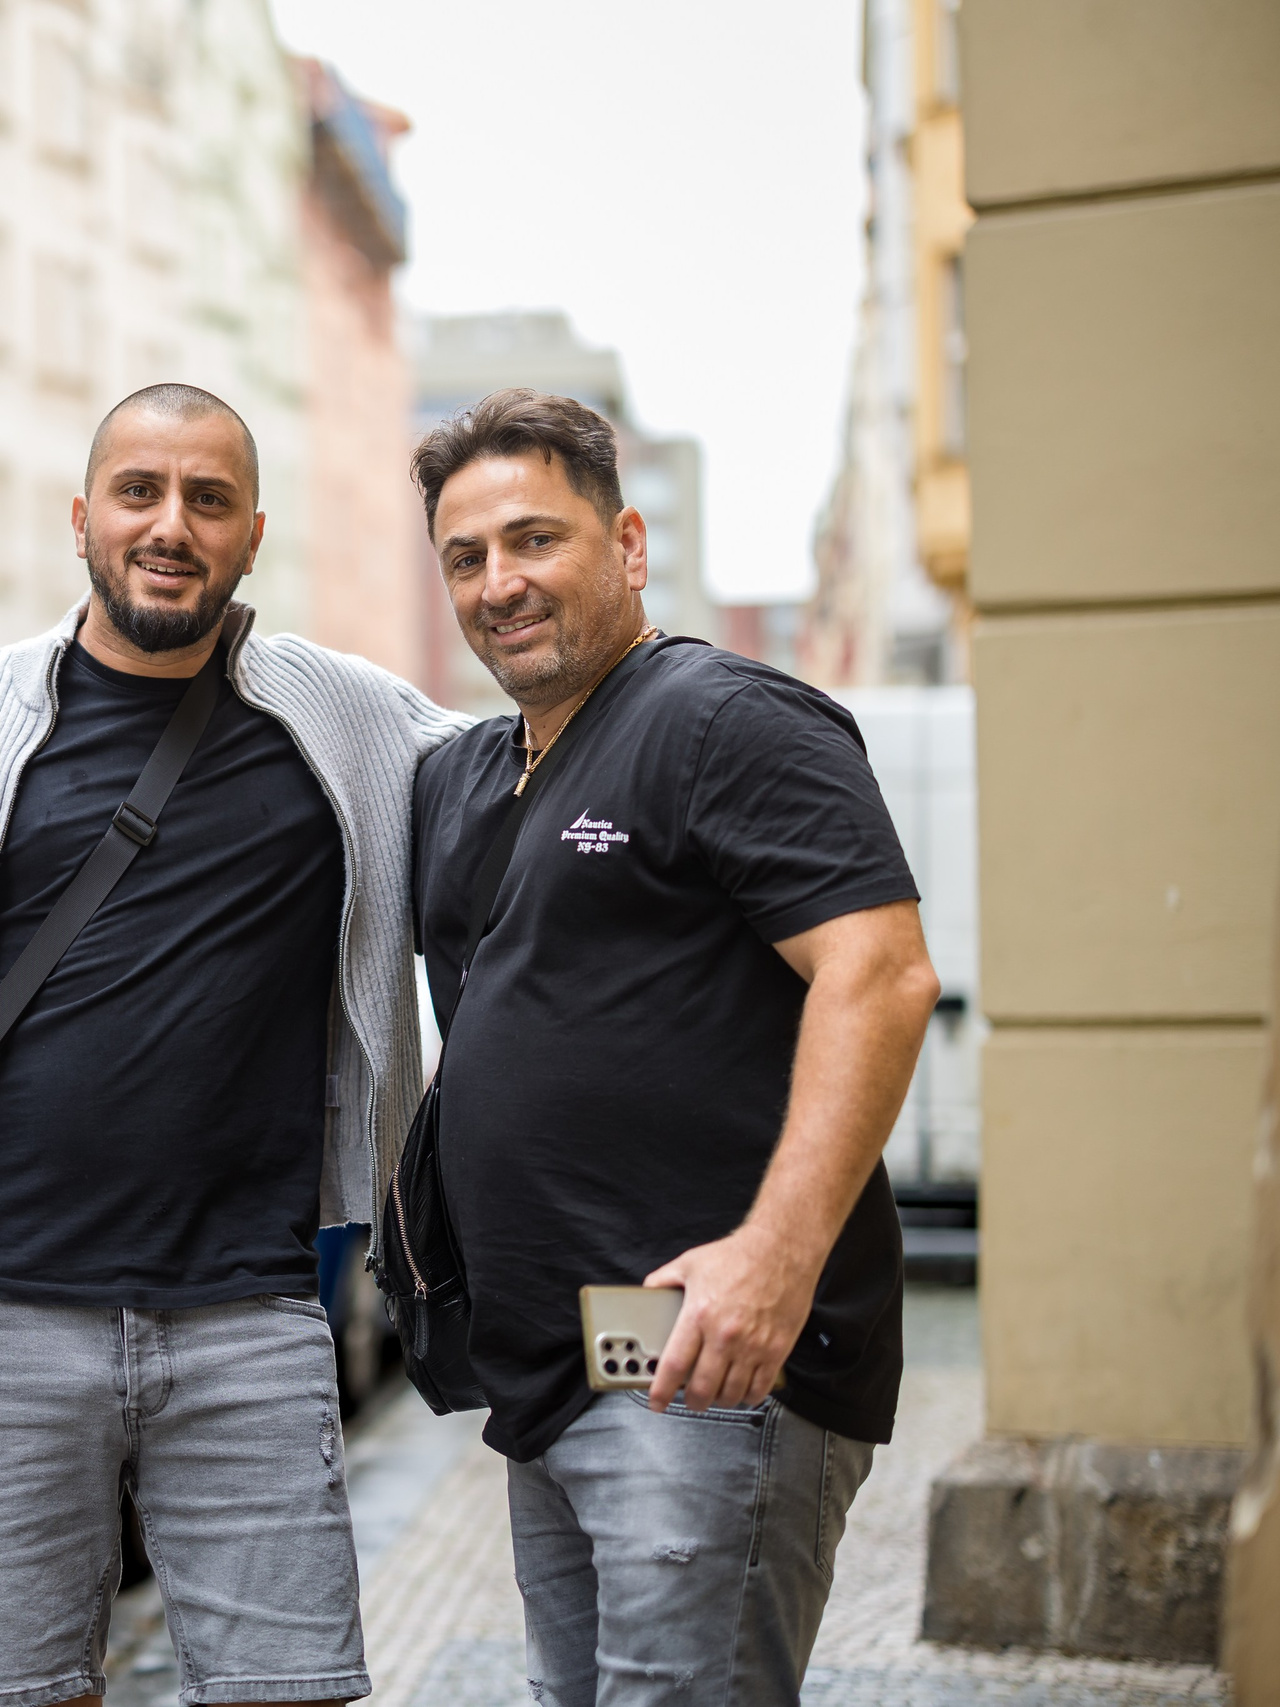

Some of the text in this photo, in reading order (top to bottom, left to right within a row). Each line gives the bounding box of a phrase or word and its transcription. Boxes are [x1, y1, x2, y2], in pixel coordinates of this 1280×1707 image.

[581, 819, 612, 829] Nautica
[561, 830, 629, 843] Premium Quality
